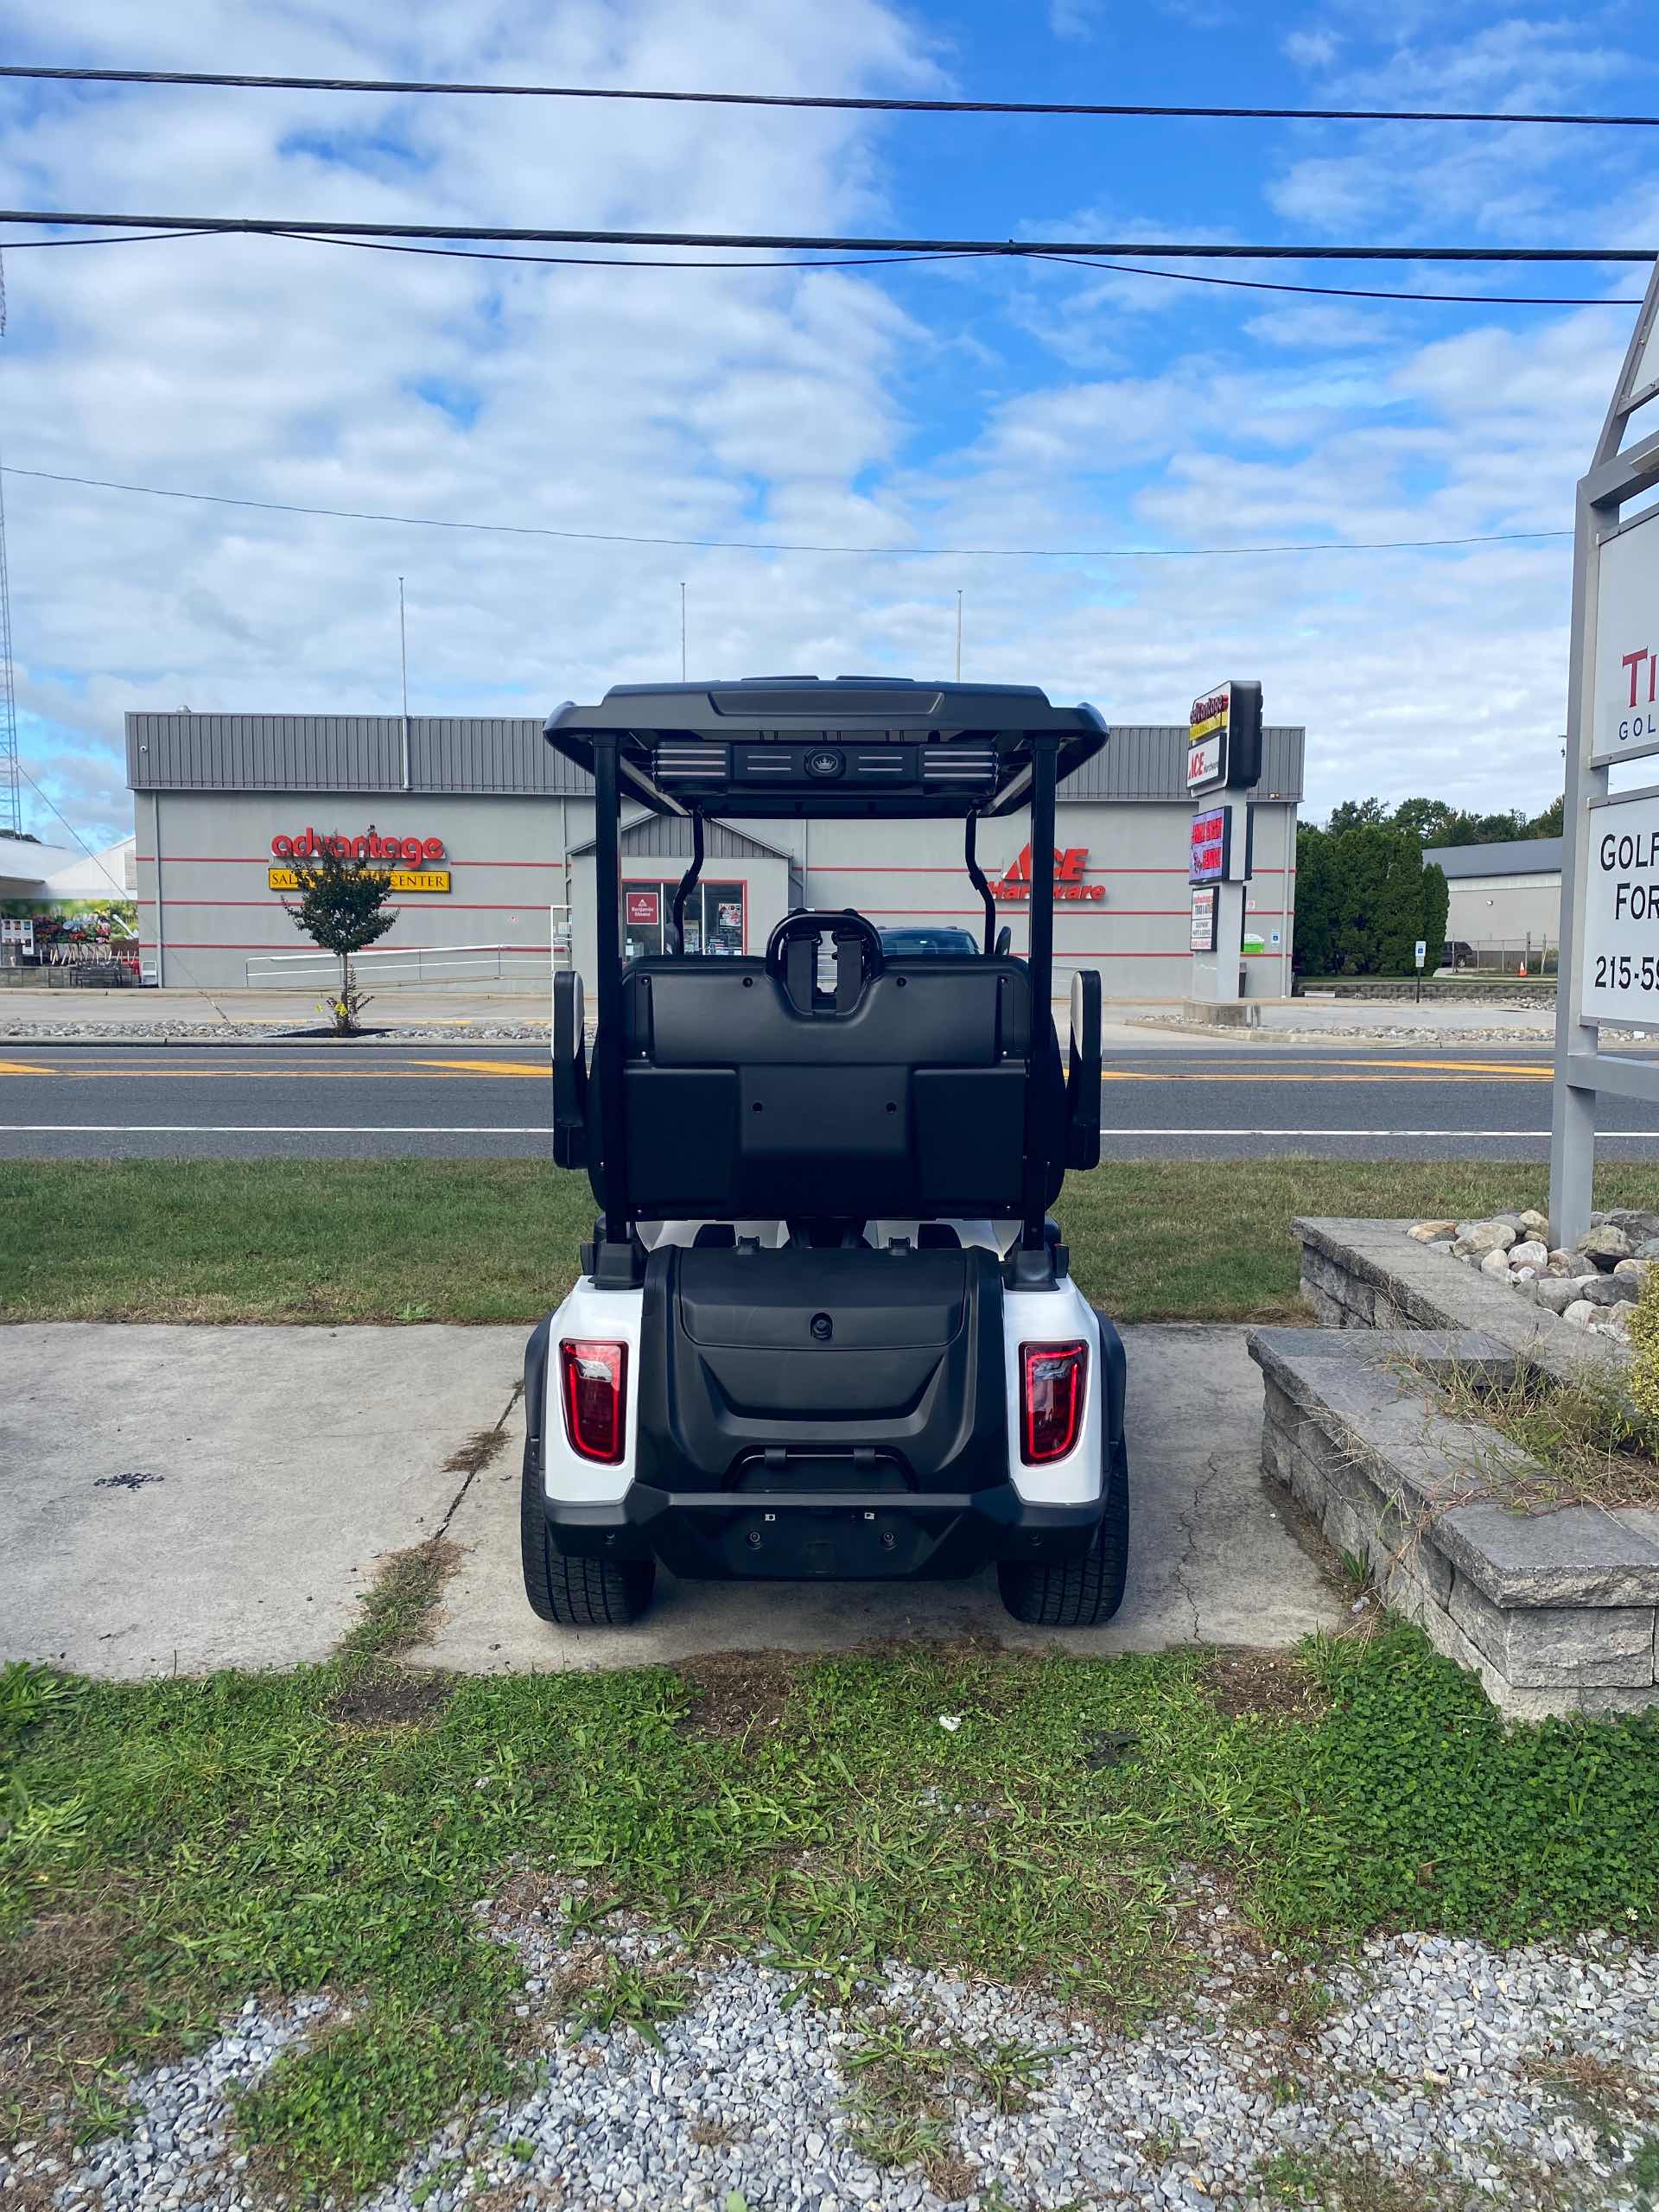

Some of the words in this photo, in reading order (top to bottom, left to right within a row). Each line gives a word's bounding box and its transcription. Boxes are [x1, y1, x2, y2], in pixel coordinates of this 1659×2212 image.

[1188, 751, 1205, 779] ACE
[271, 827, 445, 869] advantage
[391, 874, 444, 887] CENTER
